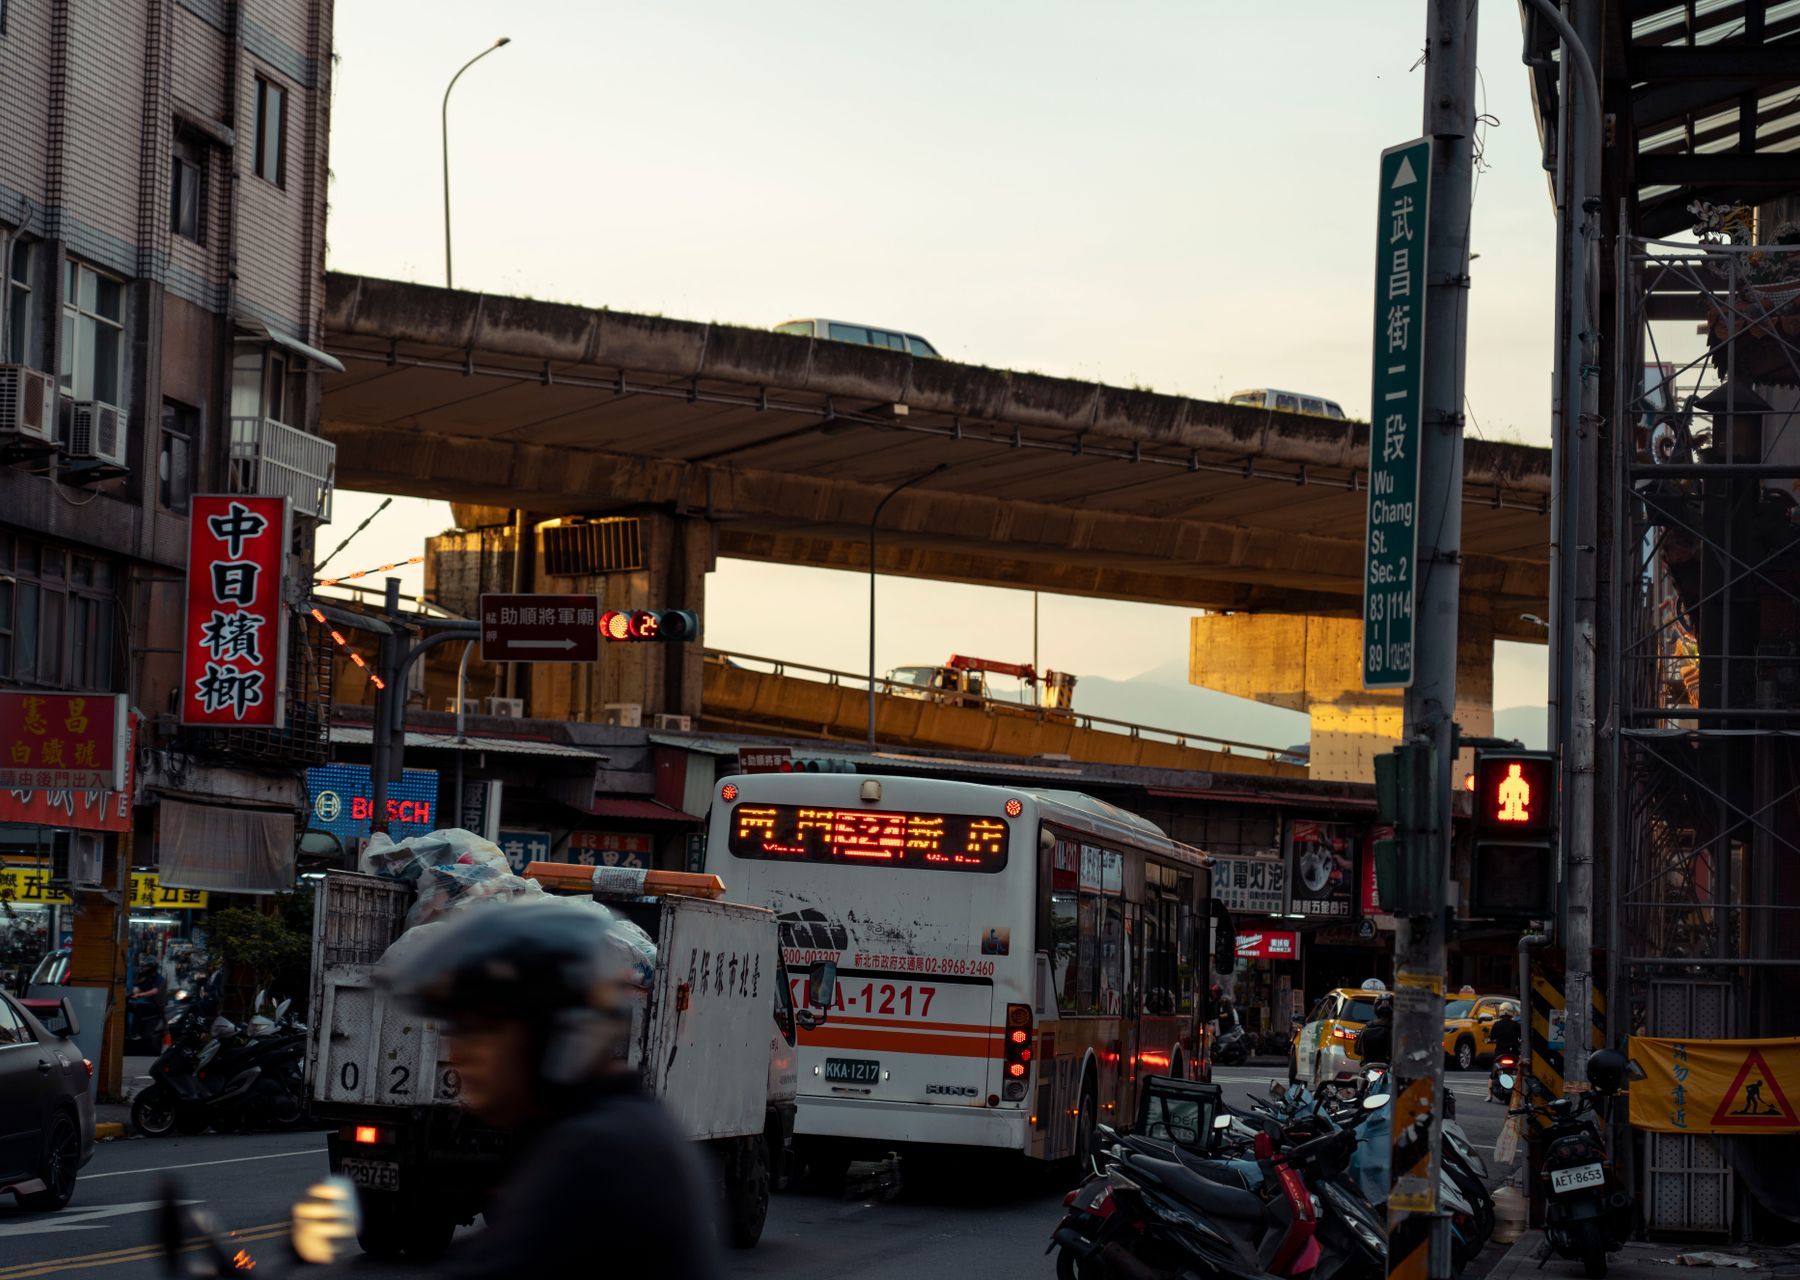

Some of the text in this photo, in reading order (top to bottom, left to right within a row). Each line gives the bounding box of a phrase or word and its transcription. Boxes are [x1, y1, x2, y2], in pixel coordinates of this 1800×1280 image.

[1383, 195, 1414, 462] 武昌街二段
[1374, 470, 1393, 495] Wu
[1372, 500, 1413, 527] Chang
[1371, 529, 1387, 554] St.
[1370, 556, 1407, 584] Sec. 2
[196, 501, 268, 720] 中日檳榔
[500, 607, 595, 626] 助順將軍廟
[1370, 590, 1411, 621] 83 114
[1369, 644, 1383, 672] 89
[22, 696, 89, 735] 憲昌
[10, 737, 101, 768] 白鐵號
[0, 770, 106, 789] 請由後門出入
[499, 840, 547, 870] 克力
[854, 953, 995, 976] 新北市政府交通局 02-8968-2460
[926, 1084, 979, 1098] HINO
